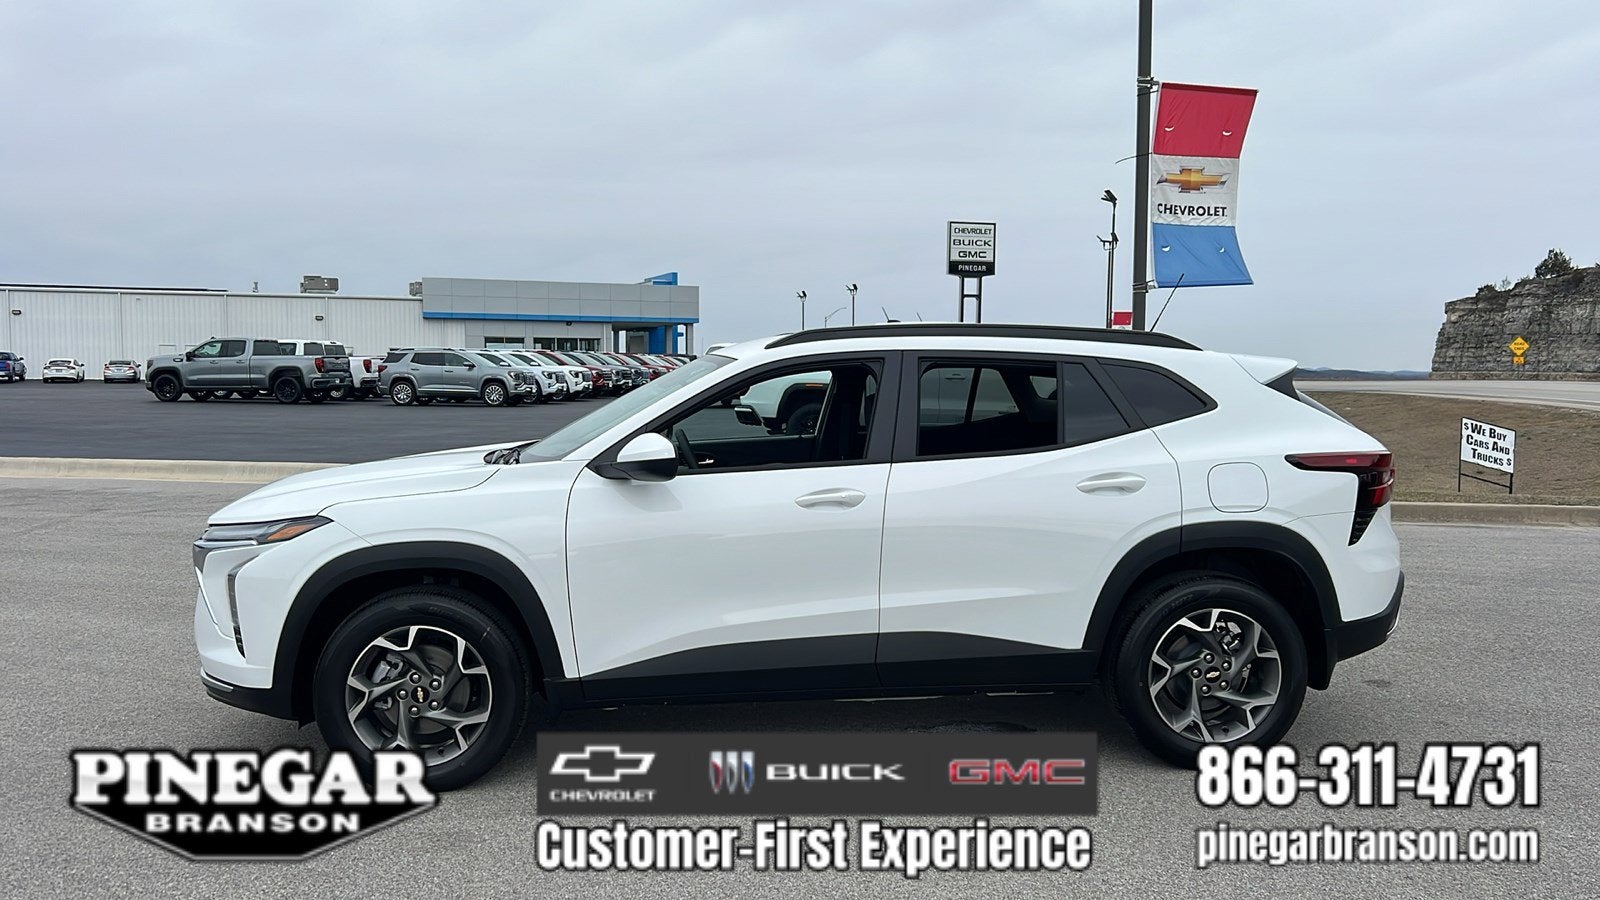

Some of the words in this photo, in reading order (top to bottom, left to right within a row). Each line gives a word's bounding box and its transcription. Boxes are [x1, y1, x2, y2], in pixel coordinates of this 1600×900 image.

[1157, 203, 1227, 217] CHEVROLET
[954, 227, 992, 235] CHEVROLET
[953, 239, 992, 247] BUICK
[958, 251, 987, 259] GMC
[958, 264, 987, 272] PINEGAR
